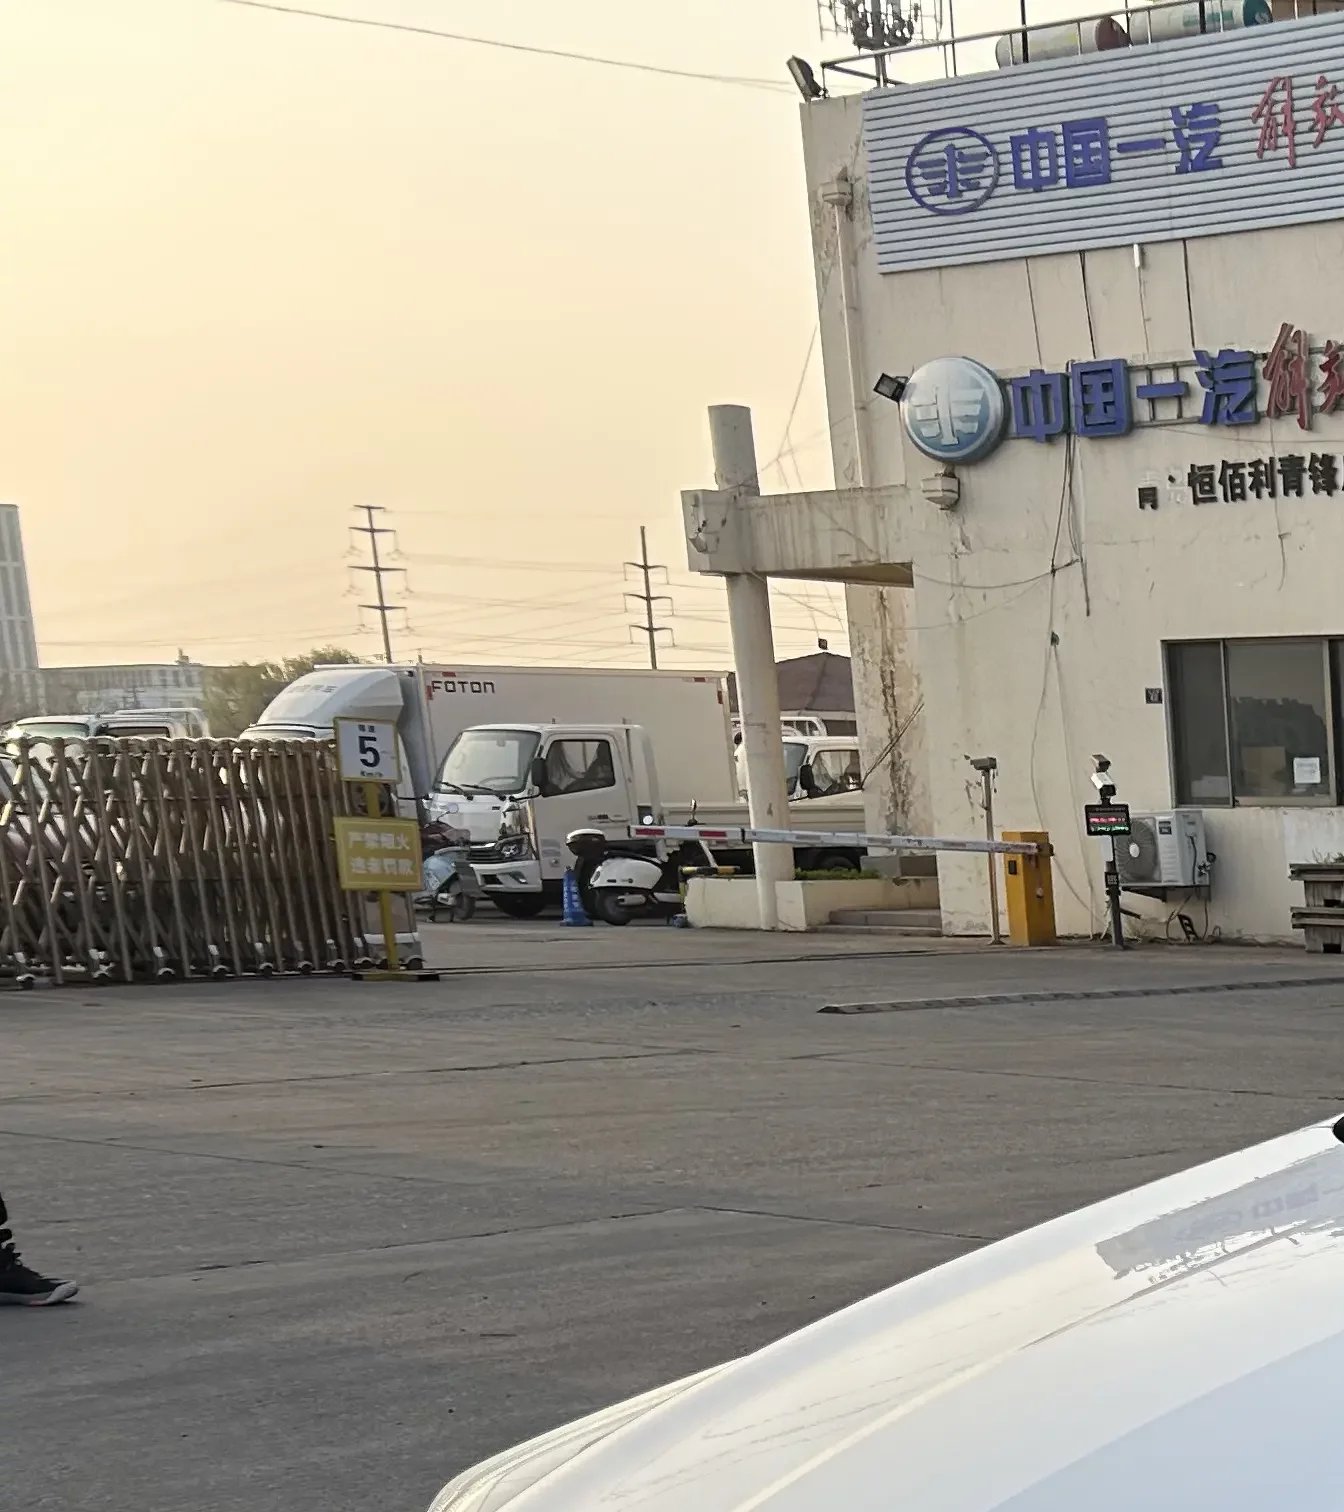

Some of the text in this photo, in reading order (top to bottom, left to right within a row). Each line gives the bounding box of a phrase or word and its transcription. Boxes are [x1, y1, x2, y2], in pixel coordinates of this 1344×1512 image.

[1010, 102, 1224, 192] 中国一汽
[1011, 348, 1260, 443] 中国一汽
[431, 680, 495, 694] FOTON
[357, 736, 381, 768] 5
